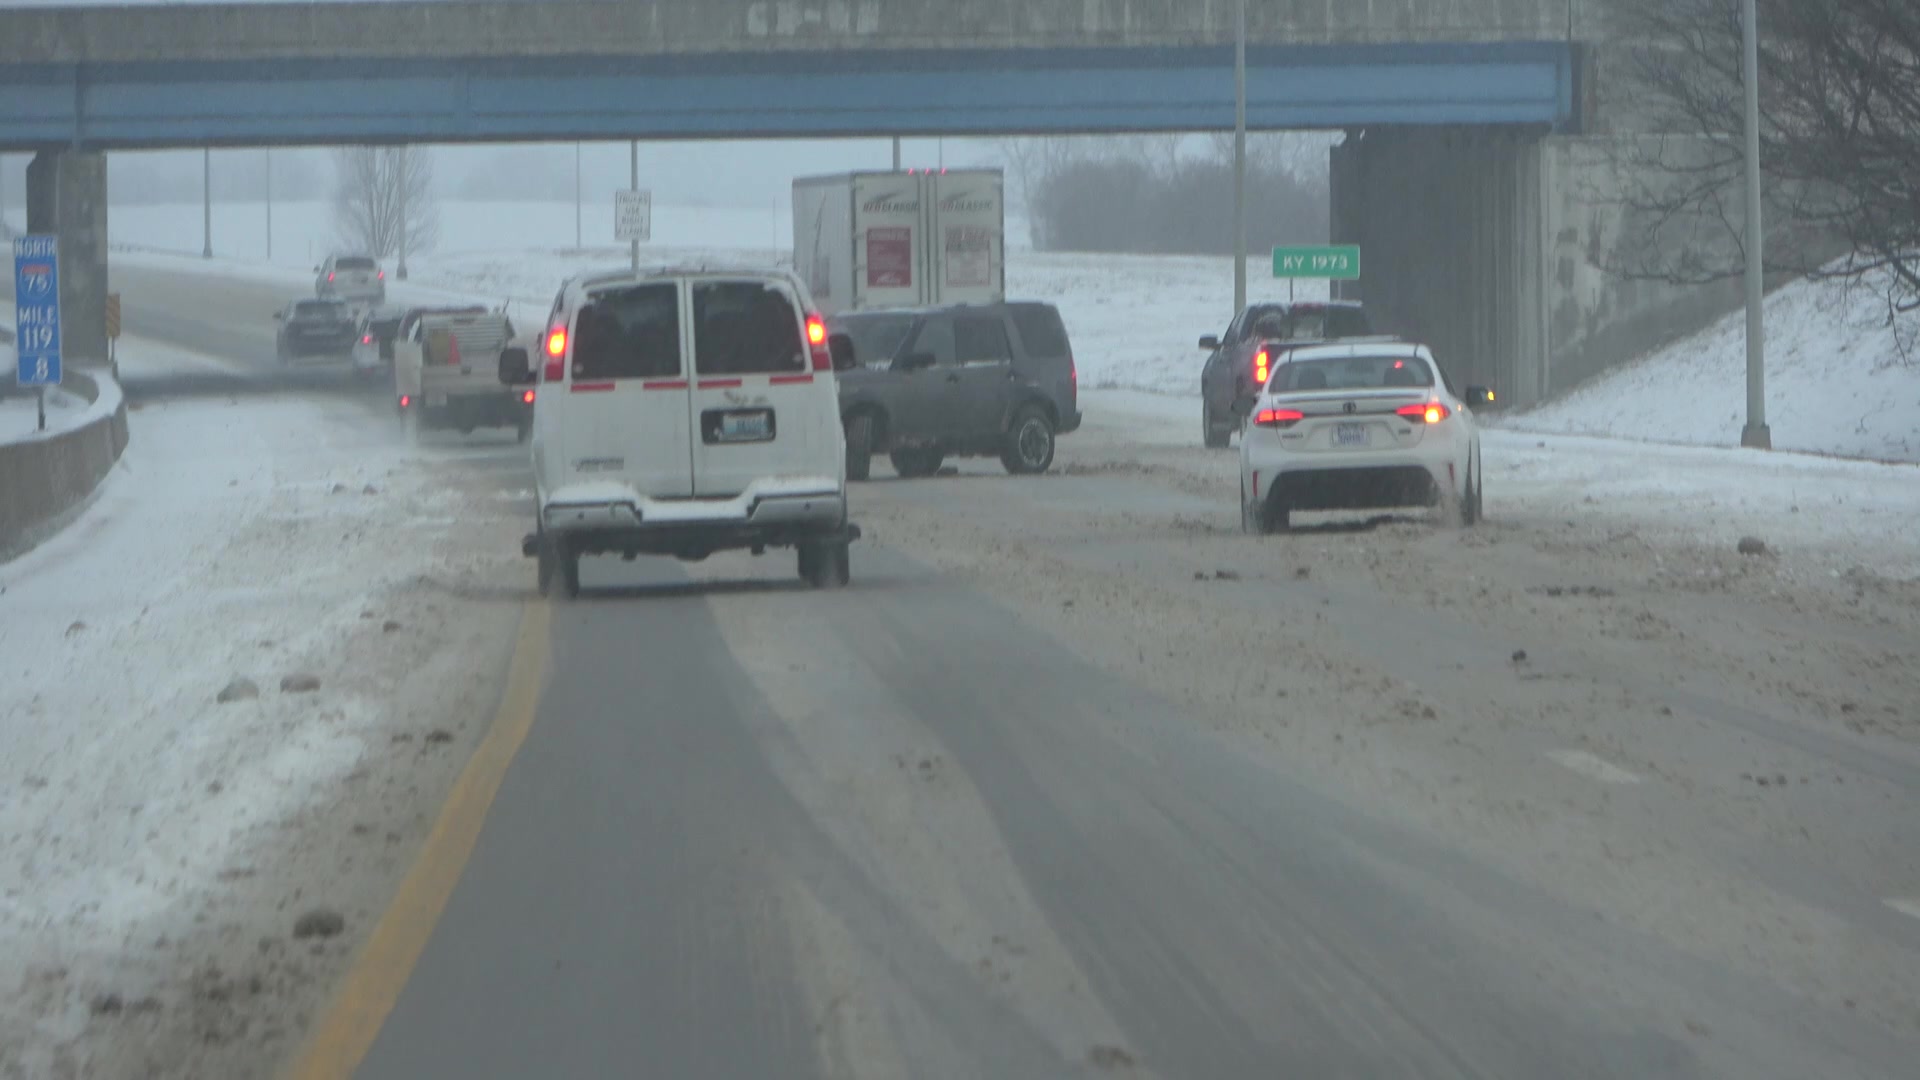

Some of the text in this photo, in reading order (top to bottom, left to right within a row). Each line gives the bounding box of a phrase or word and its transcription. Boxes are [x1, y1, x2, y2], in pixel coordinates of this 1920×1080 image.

[15, 238, 56, 257] NORTH
[1284, 254, 1348, 270] KY 1973
[24, 273, 48, 293] 75
[19, 305, 56, 326] MILE
[24, 325, 53, 351] 119
